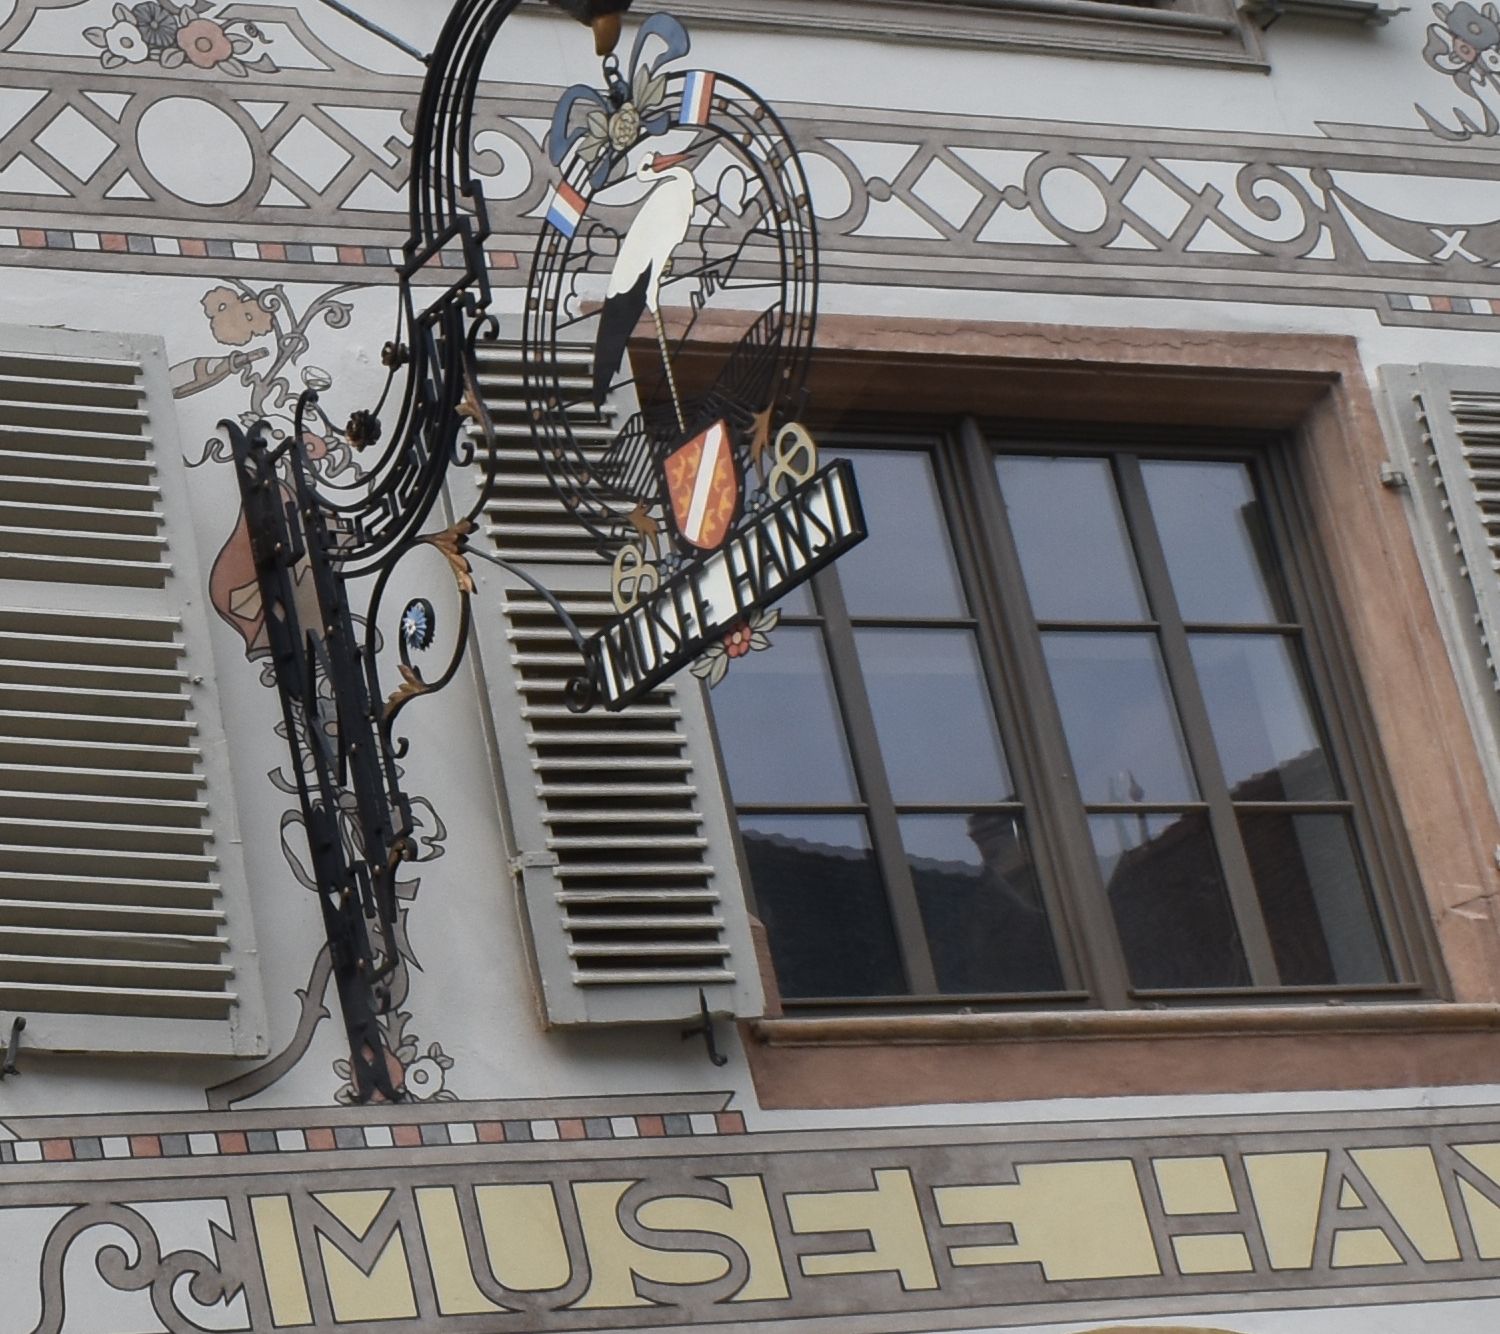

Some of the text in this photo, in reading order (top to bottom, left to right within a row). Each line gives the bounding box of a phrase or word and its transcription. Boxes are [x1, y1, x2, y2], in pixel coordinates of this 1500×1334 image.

[604, 472, 843, 701] MUSEE HANSI
[288, 1162, 1046, 1328] MUSEE
